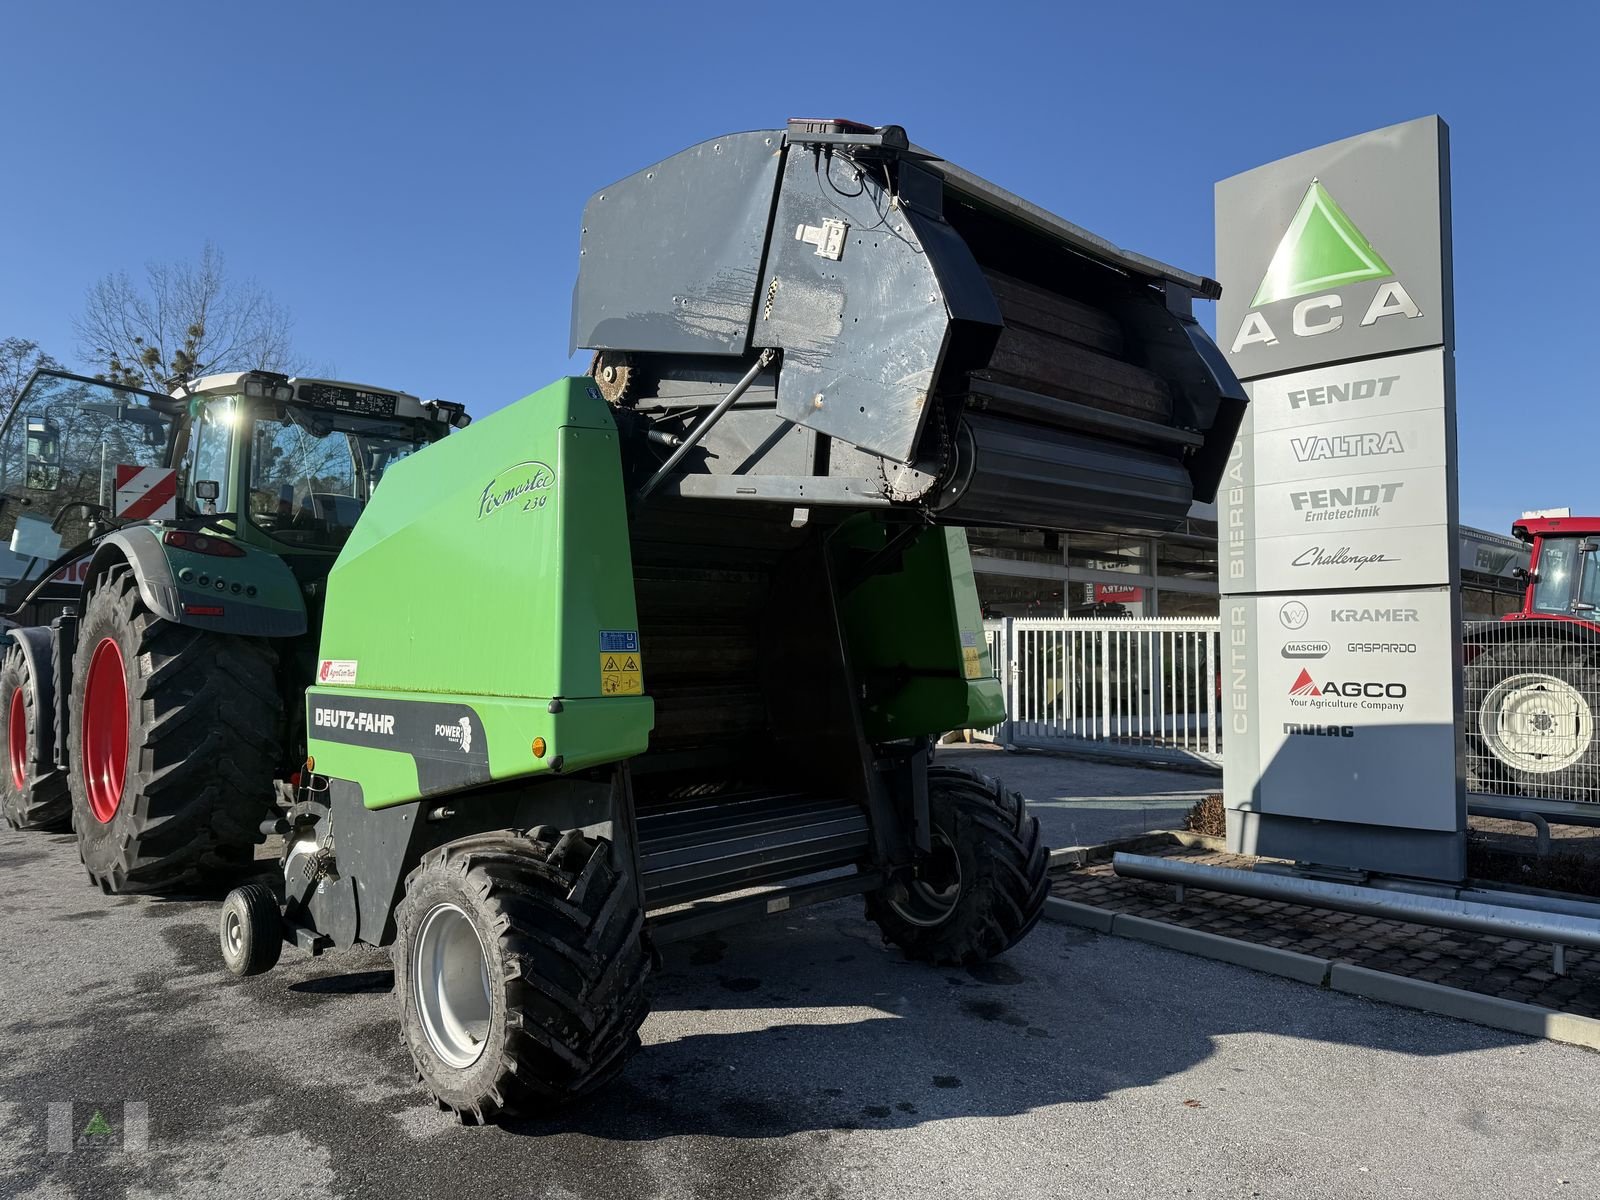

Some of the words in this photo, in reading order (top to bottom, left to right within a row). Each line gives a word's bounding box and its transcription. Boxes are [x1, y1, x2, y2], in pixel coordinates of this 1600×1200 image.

[1230, 281, 1424, 354] ACA
[1288, 376, 1400, 409] FENDT
[1290, 431, 1404, 462] VALTRA
[523, 495, 547, 511] 230
[1229, 425, 1245, 579] BIERBAU
[1290, 482, 1404, 511] FENDT
[1304, 505, 1381, 522] Erntetechnik
[1291, 546, 1402, 571] Challenger
[1331, 608, 1420, 622] KRAMER
[1287, 644, 1328, 652] MASCHIO
[1347, 643, 1417, 653] GASPARDO
[1231, 606, 1248, 734] CENTER
[1322, 681, 1407, 698] AGCO
[1289, 698, 1308, 707] Your
[1310, 699, 1358, 709] Agriculture
[1361, 700, 1404, 712] Company
[315, 707, 395, 735] DEUTZ-FAHR
[435, 724, 461, 739] POWER
[1283, 722, 1354, 738] MULAG
